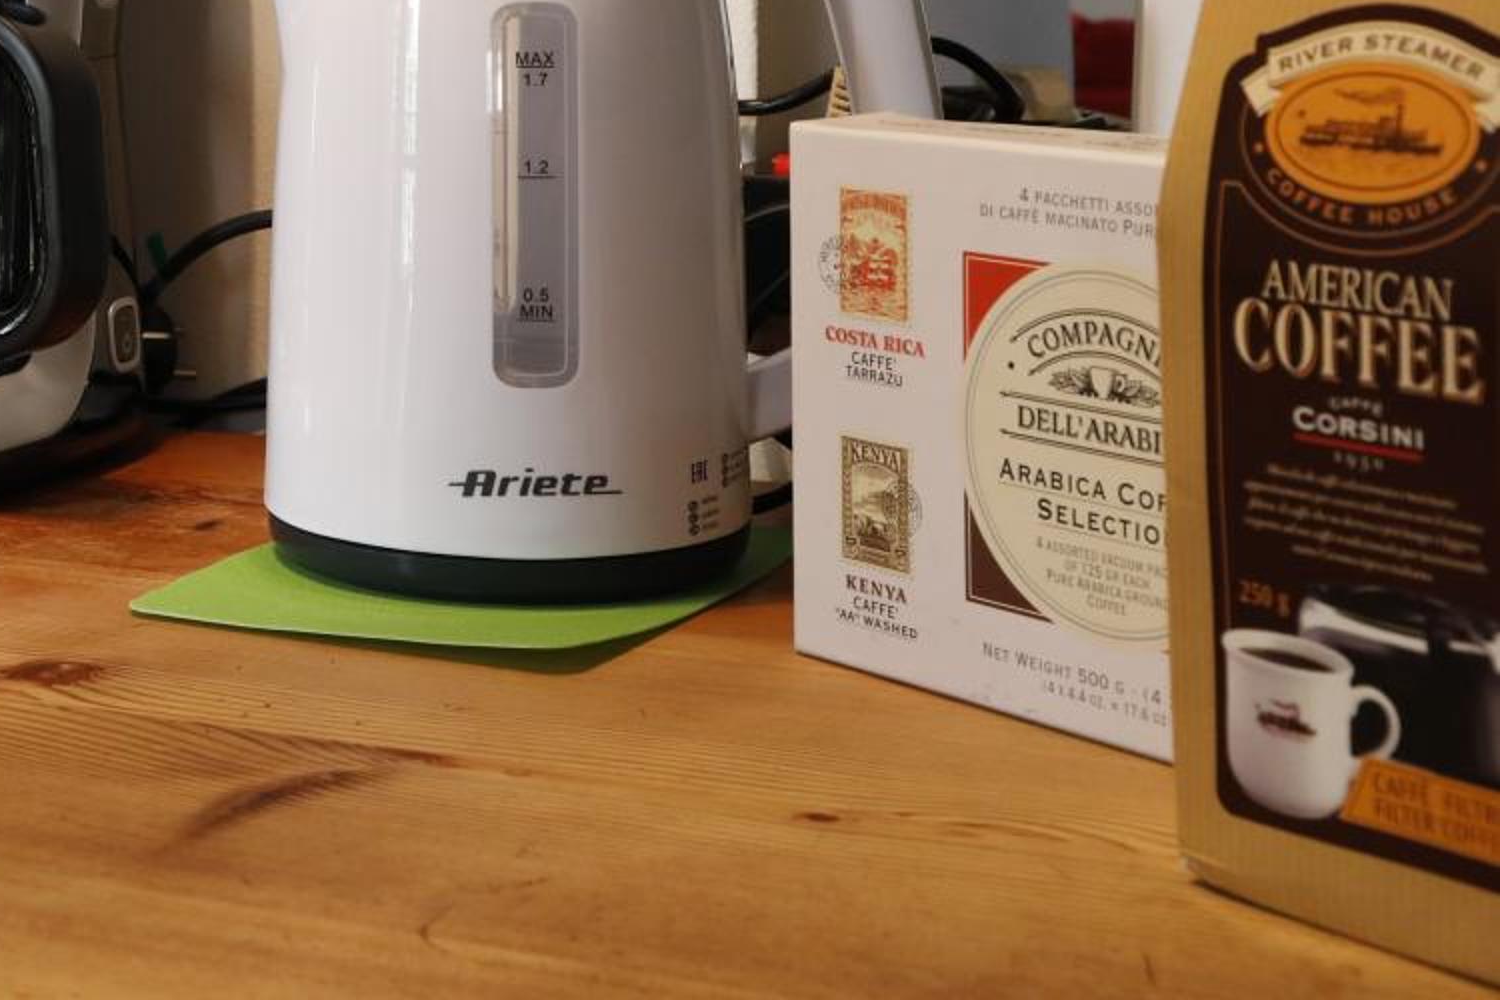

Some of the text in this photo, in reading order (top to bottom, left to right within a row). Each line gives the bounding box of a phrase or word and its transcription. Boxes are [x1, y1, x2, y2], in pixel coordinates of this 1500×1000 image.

[515, 51, 554, 66] MAX
[1279, 33, 1484, 80] RIVER STEAMER
[523, 73, 548, 87] 1.7
[523, 160, 549, 174] 1.2
[1035, 190, 1110, 212] PACCHETTI
[1267, 168, 1456, 225] COFFEE HOUSE
[980, 203, 993, 217] DI
[1045, 211, 1119, 233] MACINATO
[1123, 219, 1156, 240] PUR
[523, 288, 549, 302] 0.5
[1262, 259, 1453, 321] AMERICAN
[519, 304, 553, 318] MIN
[825, 325, 925, 359] COSTA RICA
[1233, 296, 1485, 406] COFFEE
[1018, 405, 1160, 454] DELL'ARABI
[1292, 405, 1425, 450] CORSINI
[852, 440, 899, 474] KENYA
[448, 467, 623, 497] Ariete
[1000, 458, 1106, 500] ARABICA
[1037, 498, 1160, 545] SELECTIO
[1046, 567, 1074, 588] PURE
[1077, 576, 1121, 599] ARABICA
[1082, 563, 1101, 580] 125
[846, 574, 907, 604] KENYA
[1086, 593, 1126, 616] COFFEE
[864, 615, 918, 640] WASHED
[983, 642, 1008, 662] NET
[1015, 651, 1071, 679] WEIGHT
[1077, 666, 1109, 690] 500
[1373, 797, 1436, 831] FILTER
